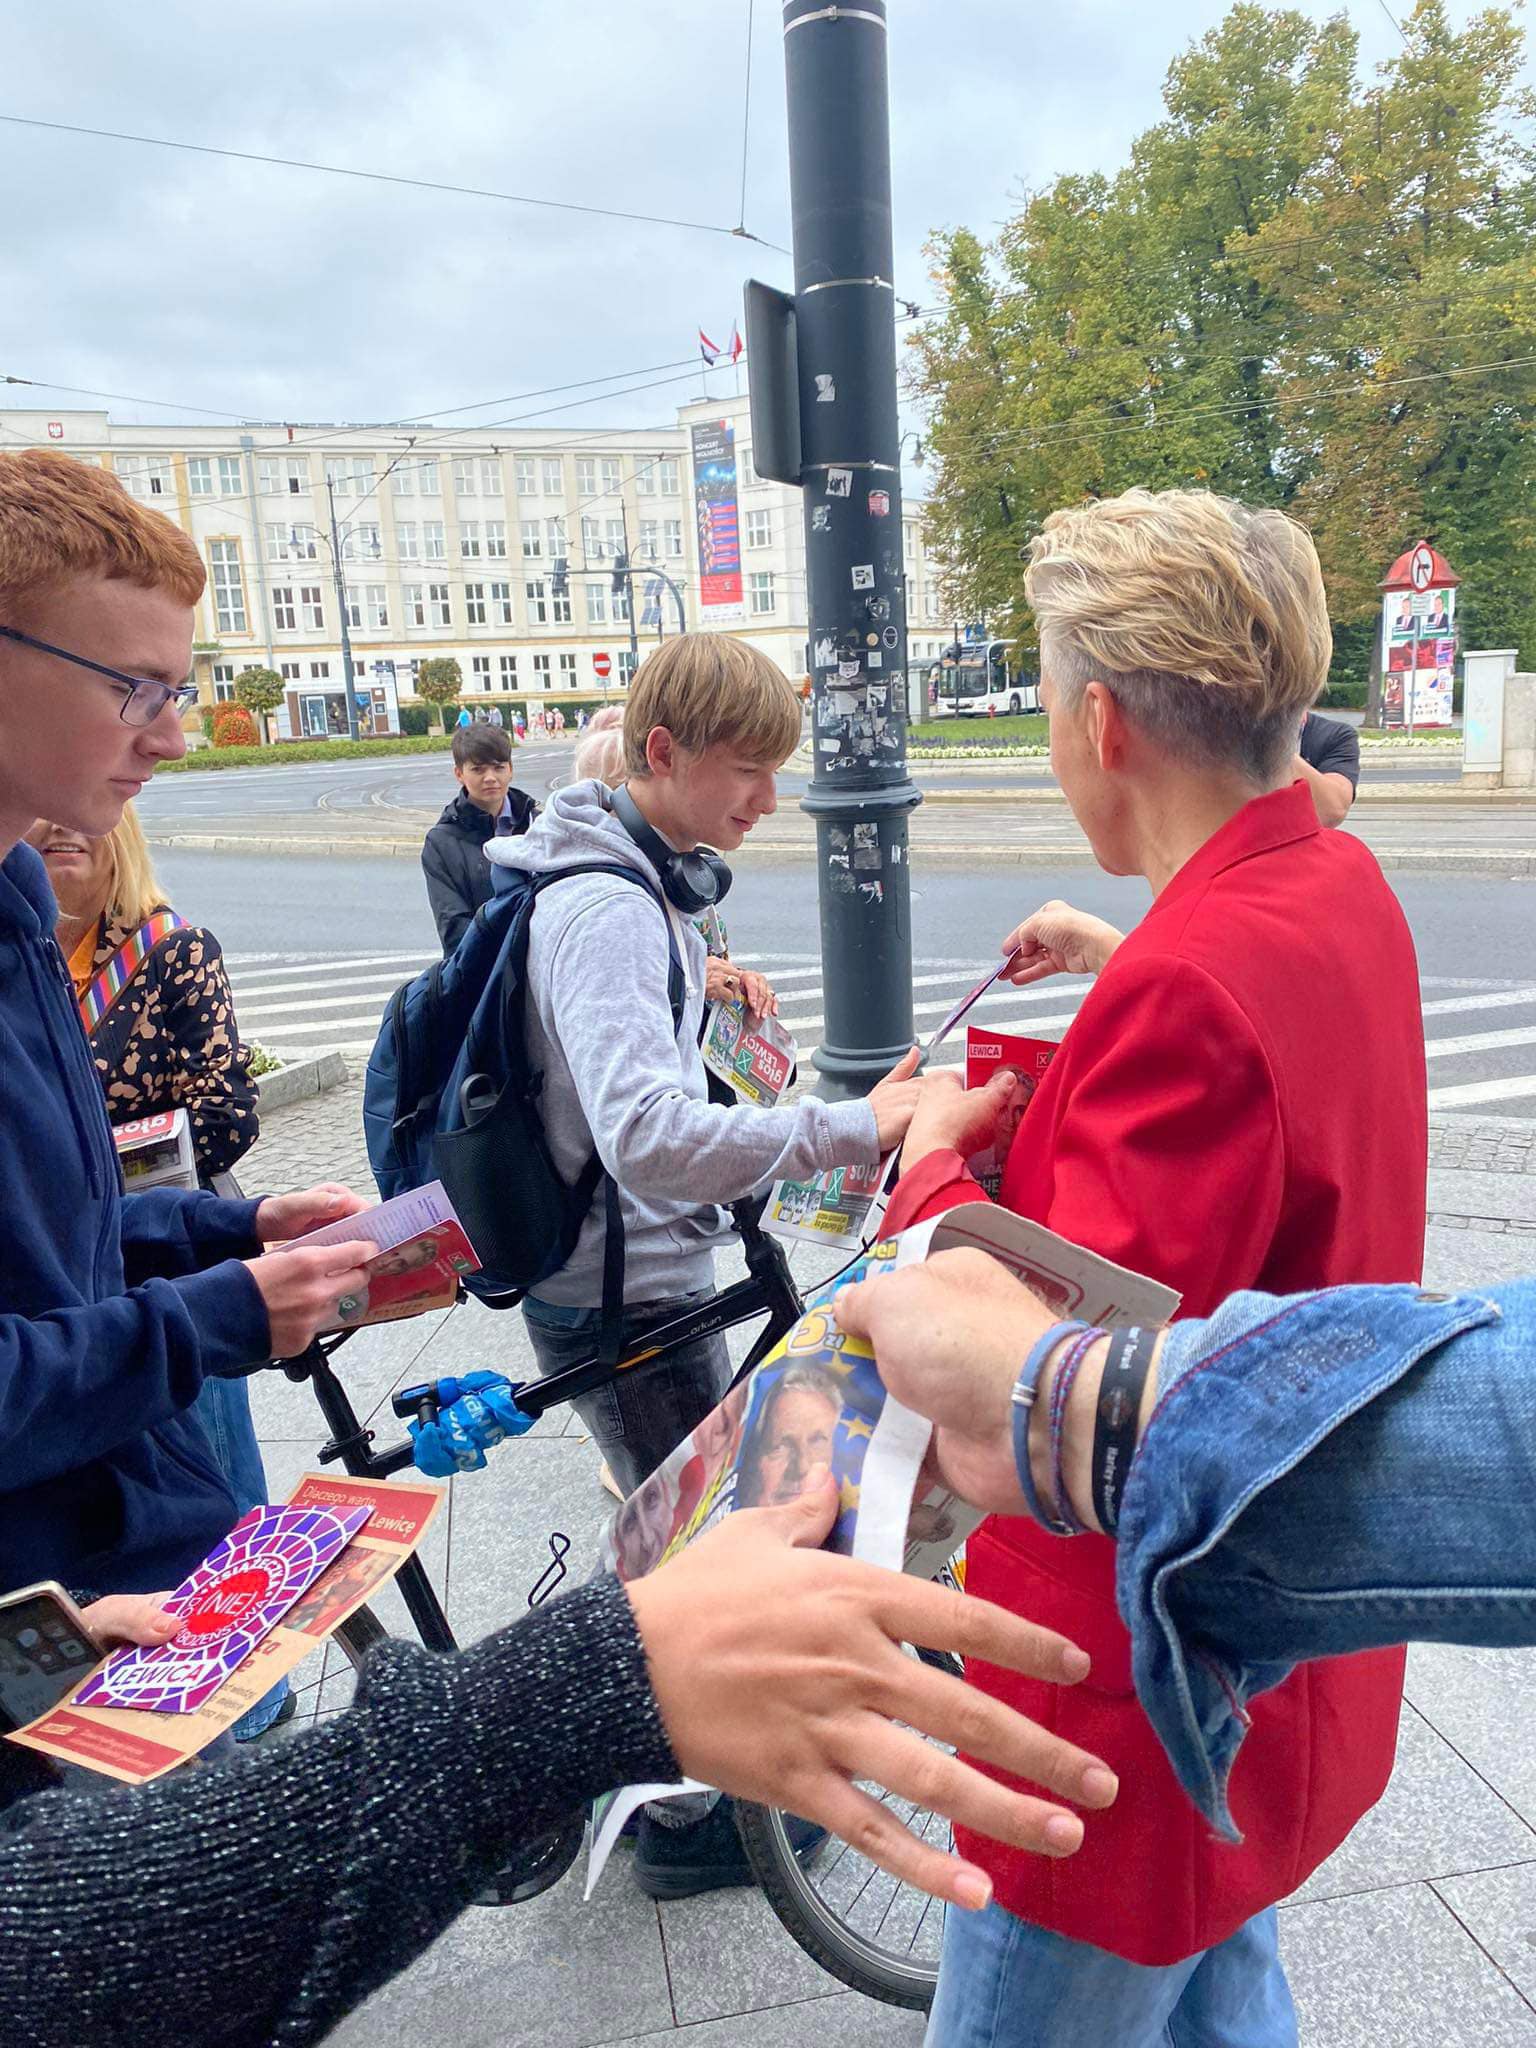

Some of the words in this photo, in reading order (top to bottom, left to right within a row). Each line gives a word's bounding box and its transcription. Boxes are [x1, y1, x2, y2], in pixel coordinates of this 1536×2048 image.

[970, 1046, 1000, 1056] LEWICA
[302, 1485, 347, 1505] Dlaczego
[110, 1664, 205, 1686] LEWICA
